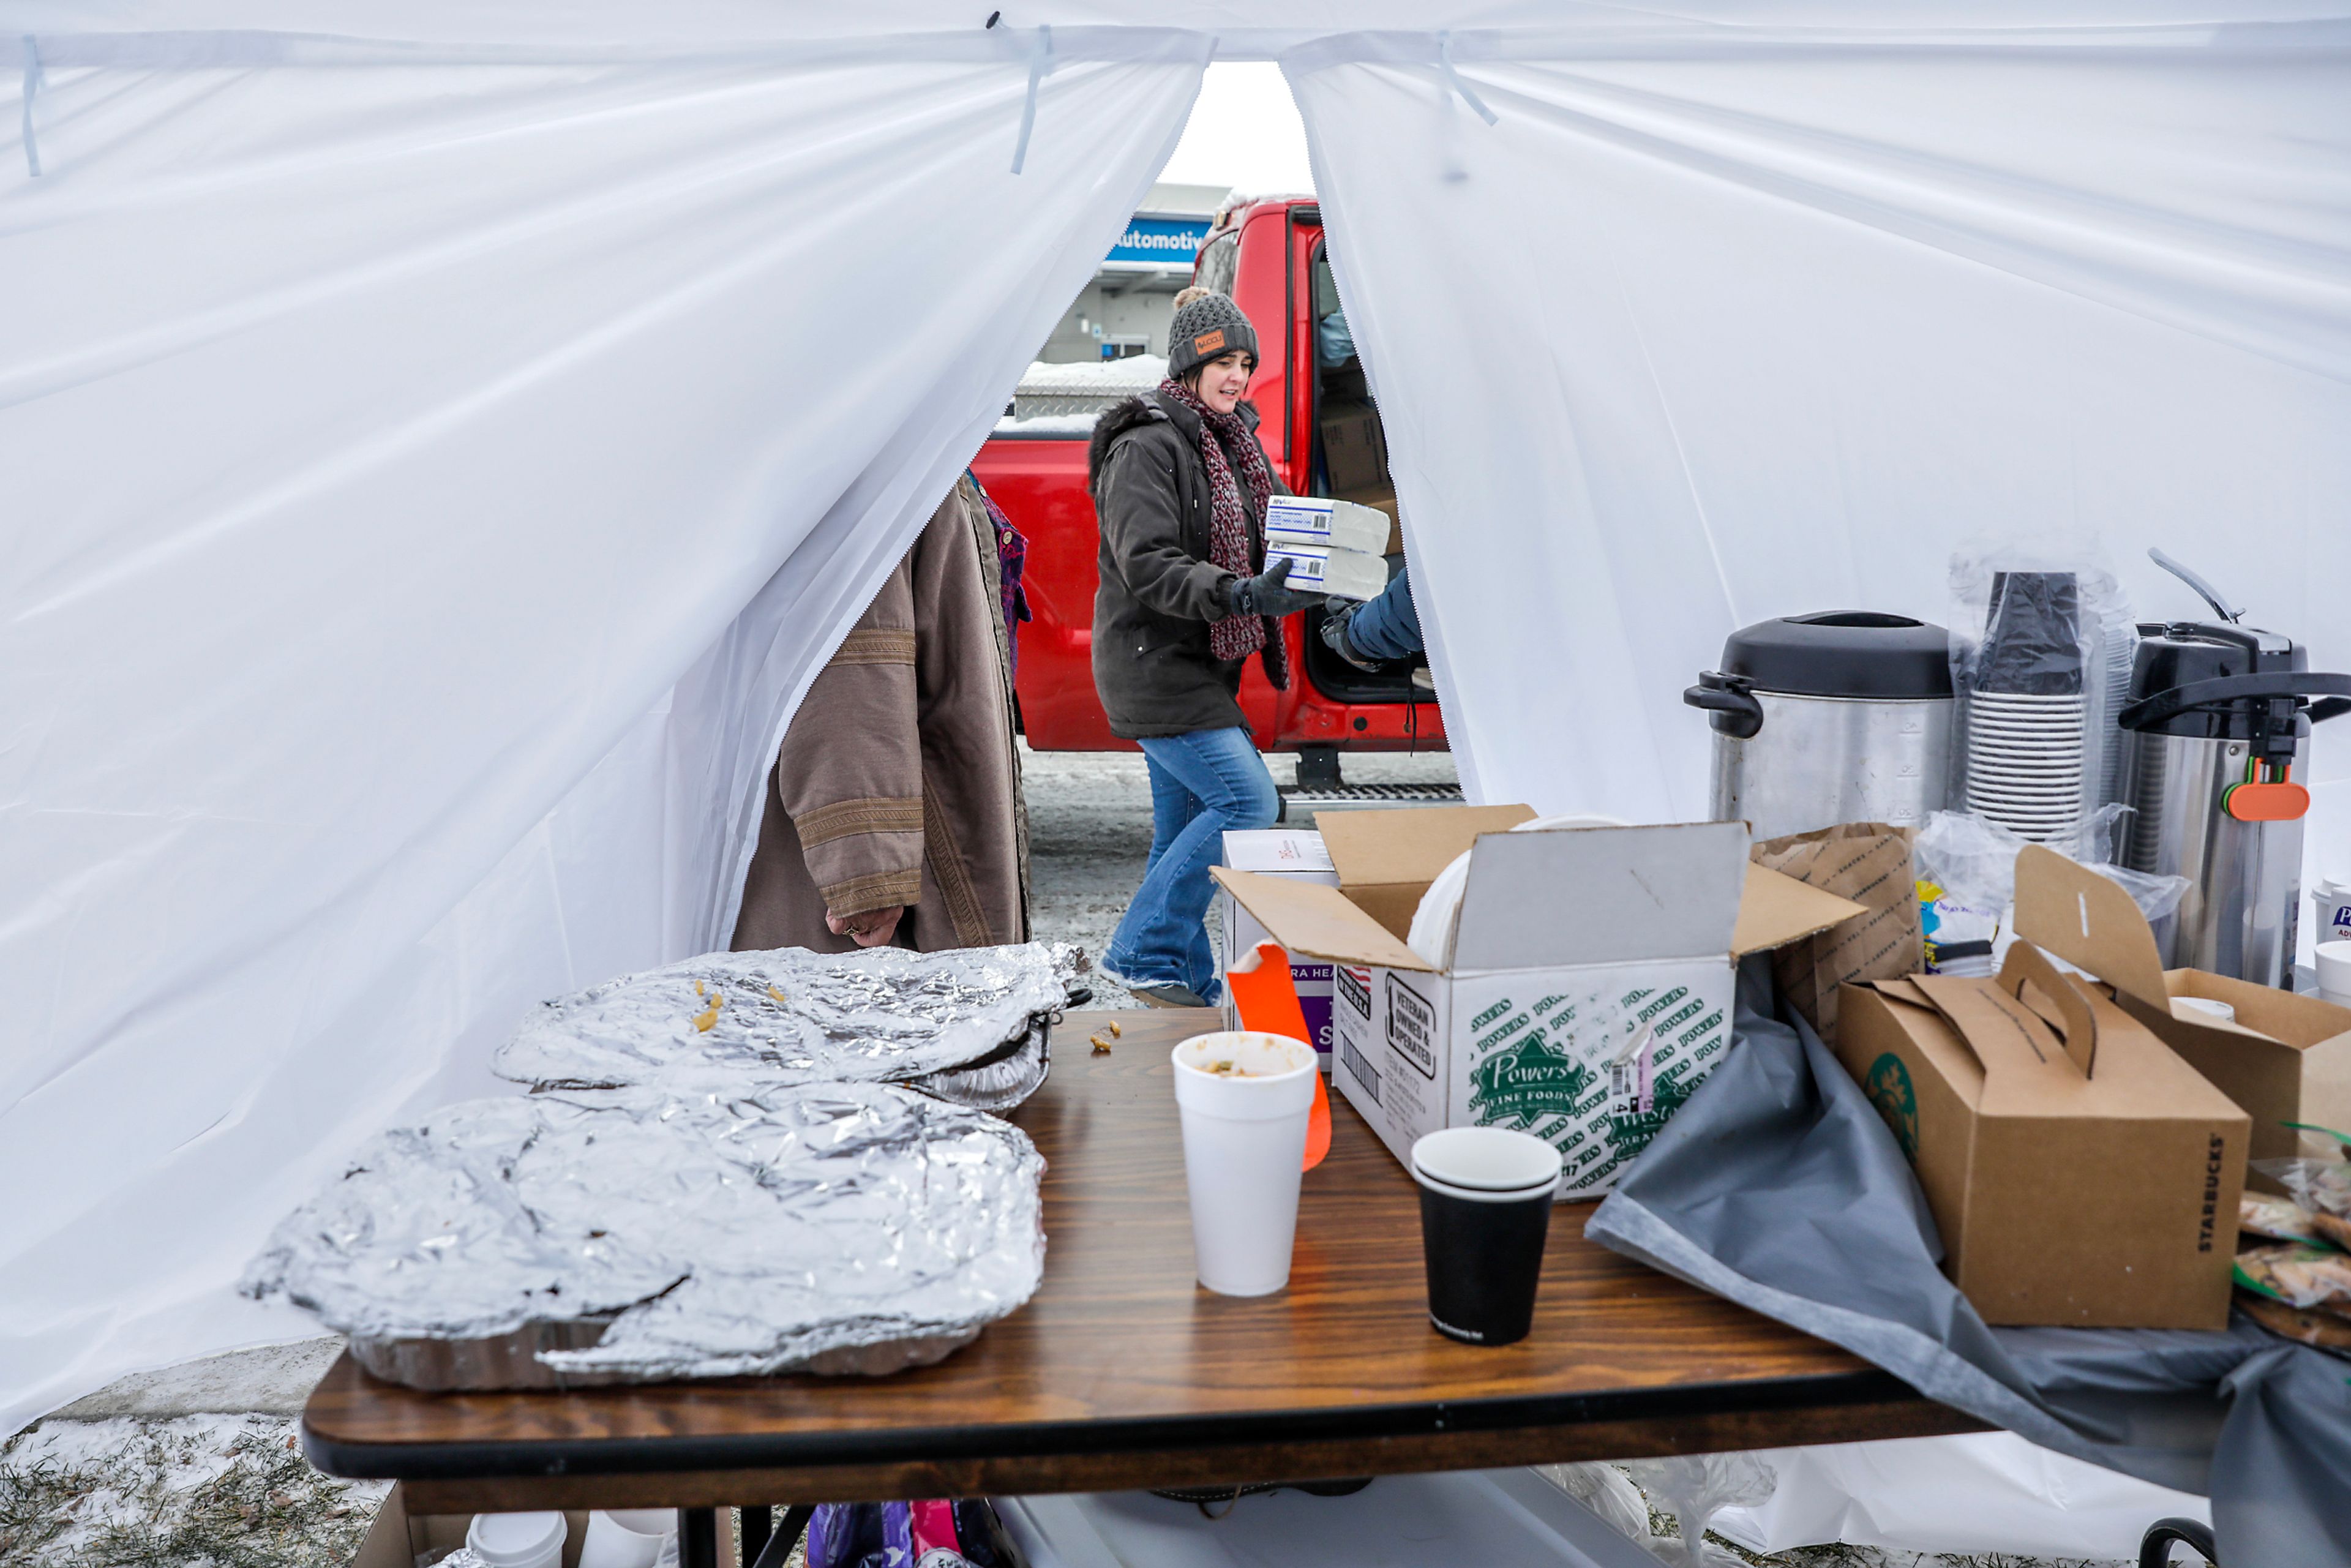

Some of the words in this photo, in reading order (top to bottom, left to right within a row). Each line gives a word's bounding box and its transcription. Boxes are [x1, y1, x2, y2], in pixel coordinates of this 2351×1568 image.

[1397, 989, 1428, 1026] VETERAN
[1637, 986, 1688, 1023] POWERS
[1654, 998, 1704, 1037] POWERS
[1395, 1008, 1422, 1040] OWNED
[1424, 1030, 1430, 1046] &
[1395, 1026, 1431, 1066] OPERATED
[1477, 1013, 1529, 1052] POWERS
[1487, 1054, 1567, 1089] Powers
[1490, 1092, 1522, 1107] FINE
[1527, 1090, 1573, 1101] FOODS
[2198, 1136, 2224, 1252] STARBUCKS
